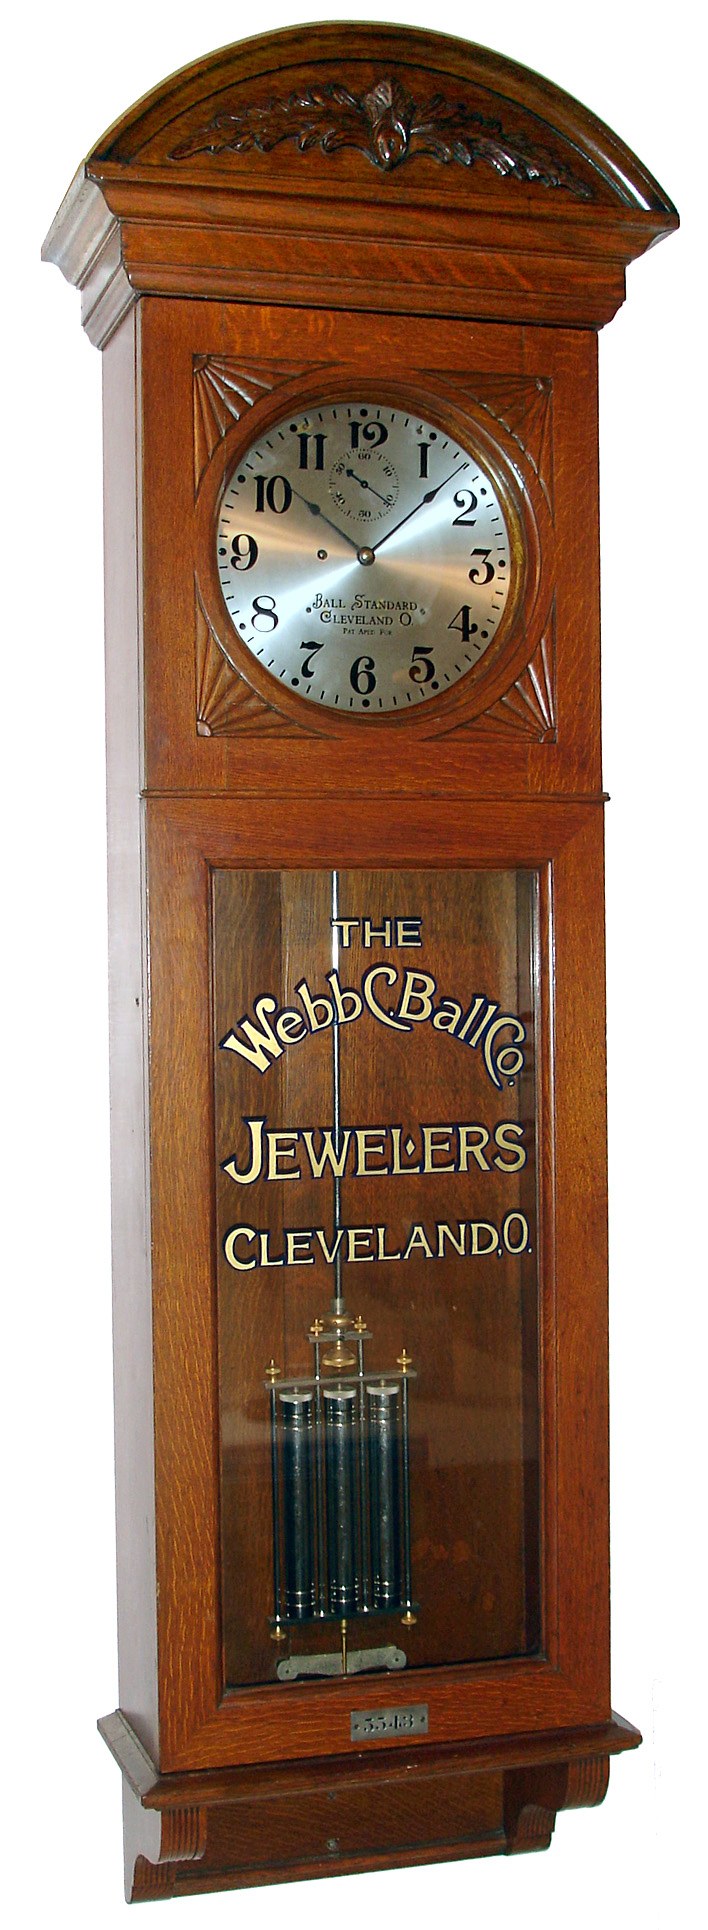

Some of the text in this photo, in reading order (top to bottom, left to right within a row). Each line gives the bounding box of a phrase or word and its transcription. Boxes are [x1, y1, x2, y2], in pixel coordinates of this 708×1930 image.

[297, 433, 327, 470] 11
[350, 421, 388, 449] 12
[383, 466, 393, 477] 10
[417, 442, 432, 478] 1
[254, 475, 292, 514] 10
[452, 489, 478, 527] 2
[230, 533, 258, 571] 9
[468, 548, 495, 585] 3
[251, 595, 279, 633] 8
[312, 593, 417, 611] BALL STANDARD
[320, 611, 393, 625] CLEVELAND
[448, 605, 477, 642] 4
[299, 641, 325, 678] 7
[350, 656, 376, 695] 6
[408, 646, 436, 684] 5
[331, 917, 423, 949] THE
[220, 970, 363, 1075] Webb
[398, 971, 498, 1049] Ball
